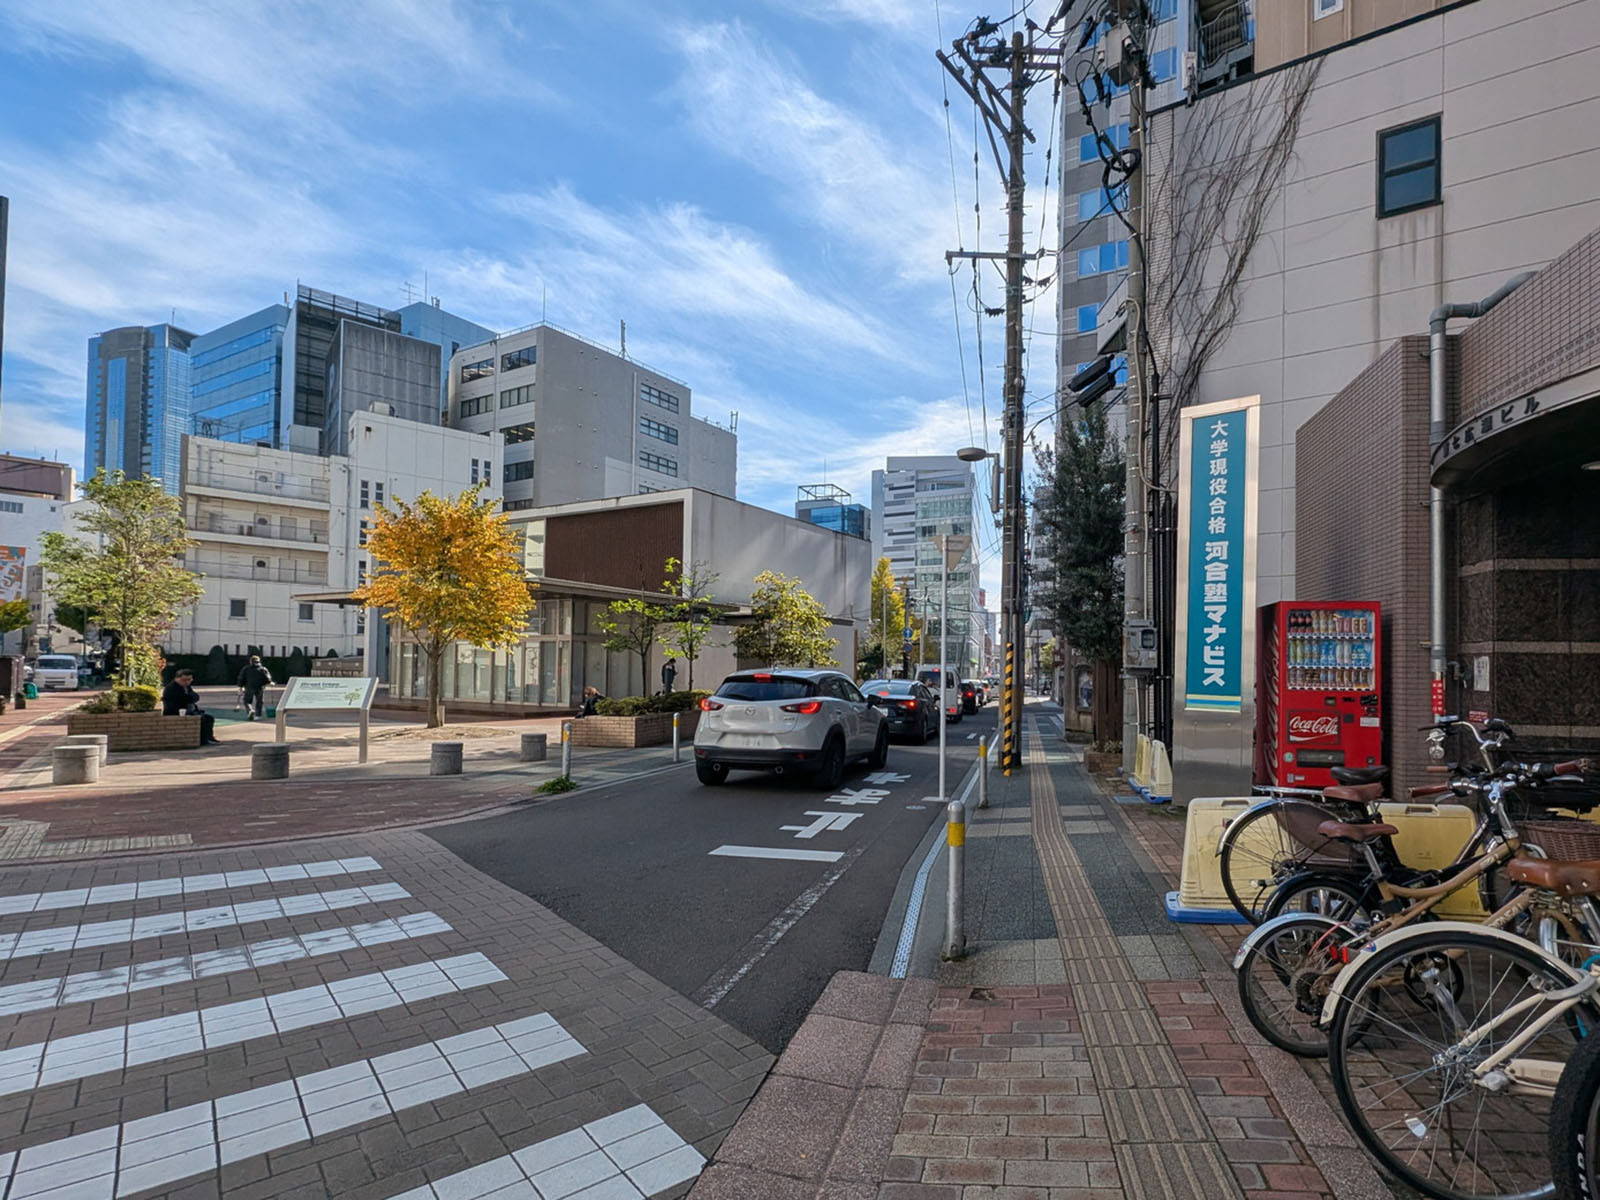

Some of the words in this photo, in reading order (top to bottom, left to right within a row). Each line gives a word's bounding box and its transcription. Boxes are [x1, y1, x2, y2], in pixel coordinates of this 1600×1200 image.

[1207, 420, 1229, 535] 大学現役合格
[1202, 540, 1229, 687] 河合塾マナビス
[1289, 716, 1338, 735] Coca-Cola
